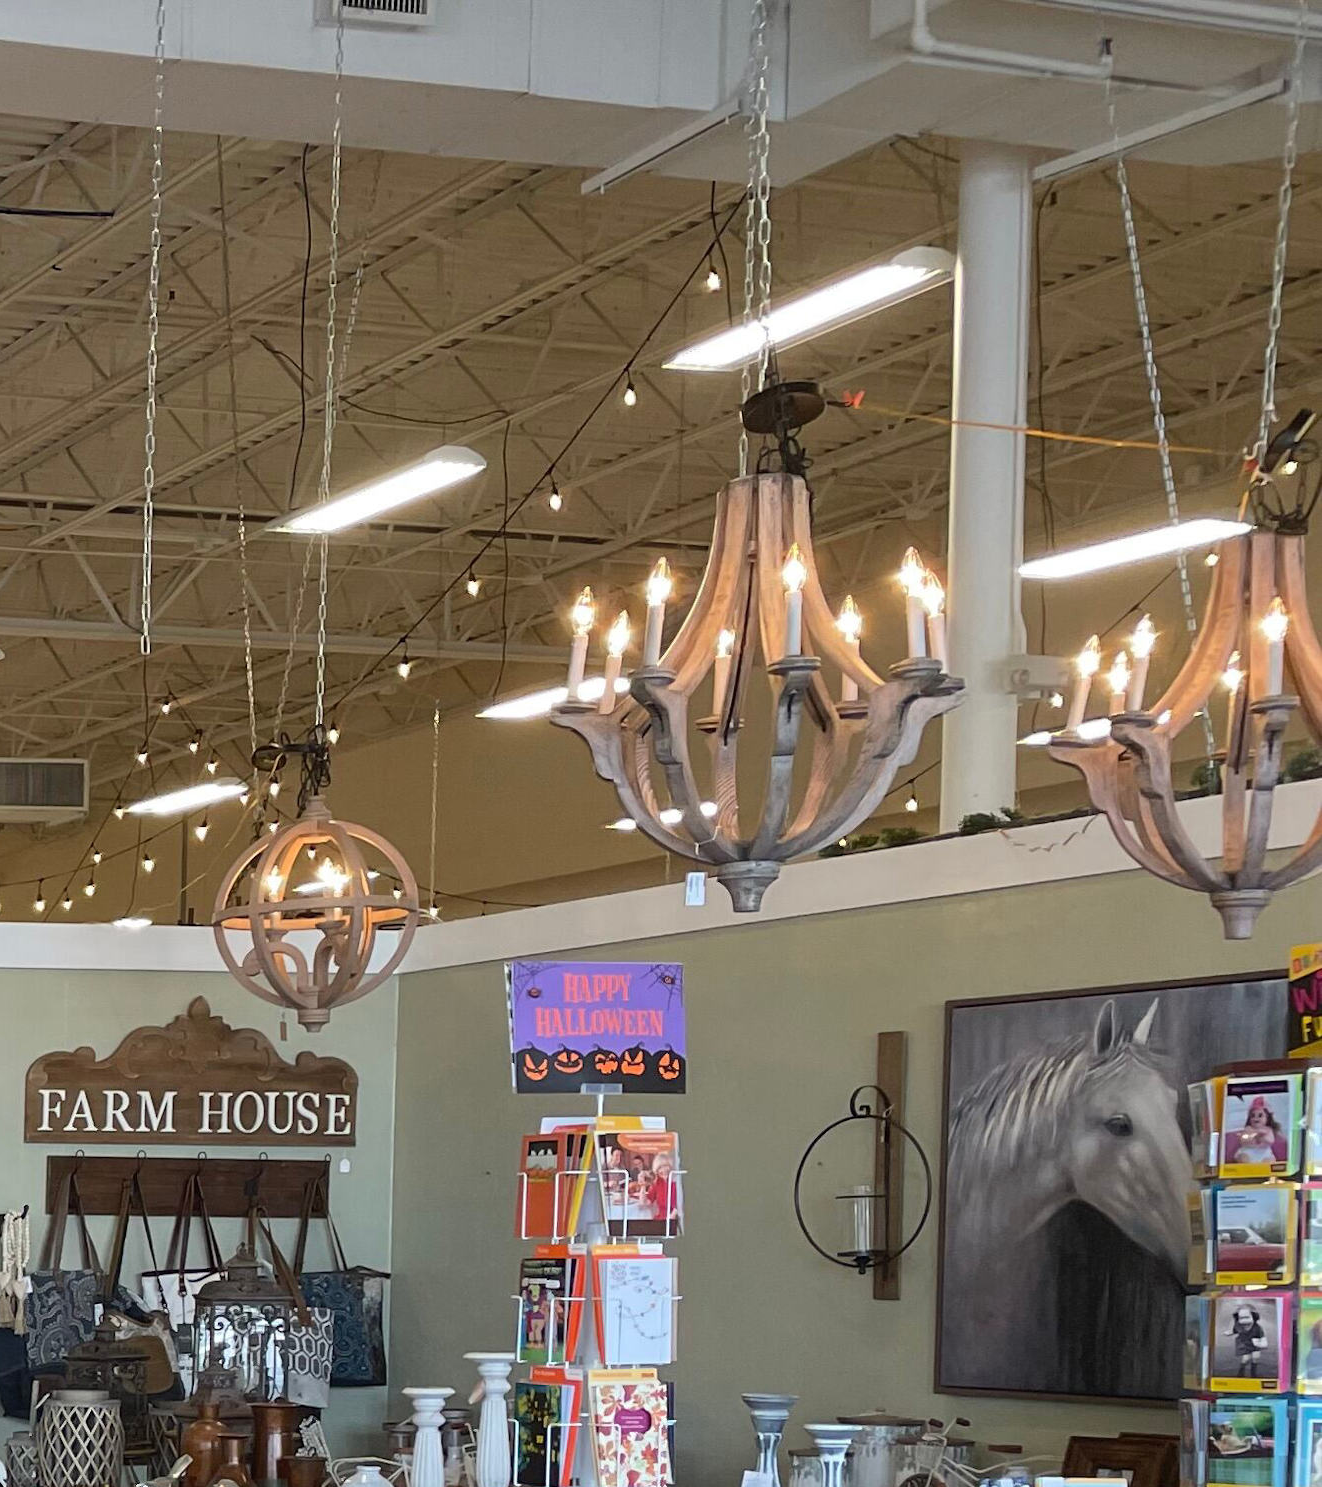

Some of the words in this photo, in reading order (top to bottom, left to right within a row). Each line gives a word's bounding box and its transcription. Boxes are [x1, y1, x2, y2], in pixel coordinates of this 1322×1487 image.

[562, 972, 632, 1004] HAPPY
[535, 1006, 664, 1039] HALLOWEEN
[36, 1089, 178, 1134] FARM
[198, 1090, 352, 1136] HOUSE
